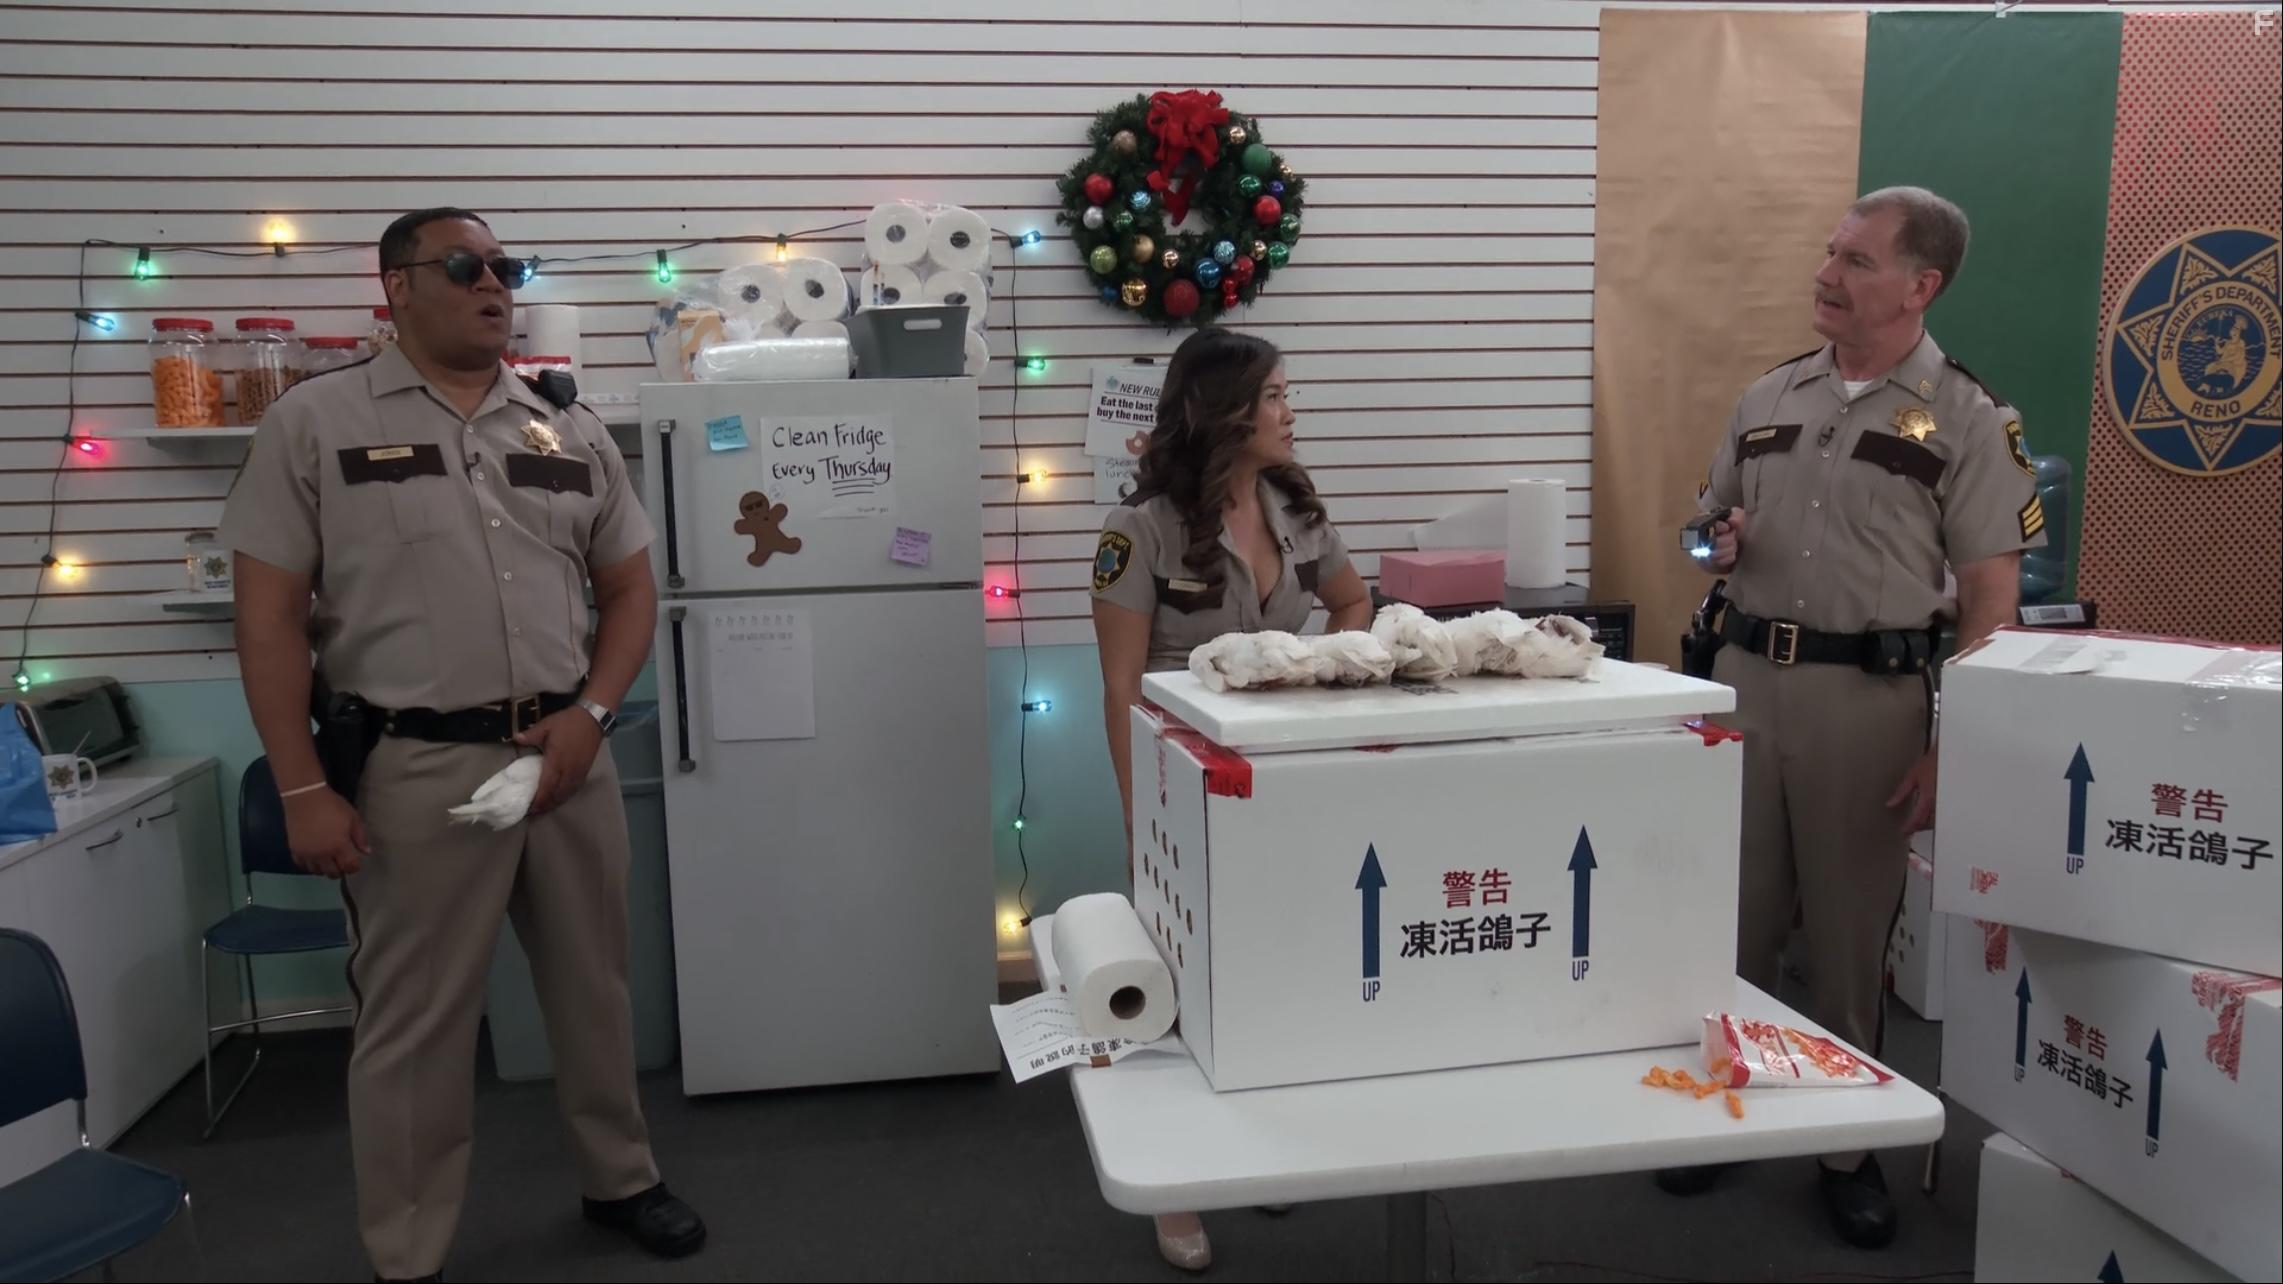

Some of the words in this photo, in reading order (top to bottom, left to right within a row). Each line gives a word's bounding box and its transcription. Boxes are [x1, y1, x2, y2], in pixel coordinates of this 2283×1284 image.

[2161, 289, 2213, 361] SHERIFF'S
[2215, 285, 2282, 359] DEPARTMENT
[1120, 383, 1142, 394] NEW
[1143, 386, 1161, 397] RUL
[1096, 407, 1114, 420] buy
[1115, 409, 1131, 420] the
[1133, 412, 1155, 423] next
[1100, 396, 1116, 407] Eat
[1118, 398, 1134, 409] the
[1135, 400, 1153, 412] last
[2190, 400, 2241, 418] RENO
[771, 426, 829, 448] Clean
[835, 423, 888, 455] Fridge
[771, 463, 816, 485] Every
[818, 455, 892, 486] Thursday
[2150, 782, 2229, 824] 警告
[2104, 818, 2274, 871] 凍活鴿子
[2066, 856, 2085, 875] UP
[1442, 867, 1513, 909] 警告
[1399, 911, 1552, 959] 凍活鴿子
[1571, 959, 1590, 982] UP
[1362, 980, 1381, 1002] UP
[2063, 1013, 2108, 1062] 警告
[2013, 1064, 2026, 1084] UP
[2036, 1038, 2134, 1110] 凍活鴿子
[2145, 1137, 2160, 1160] UP
